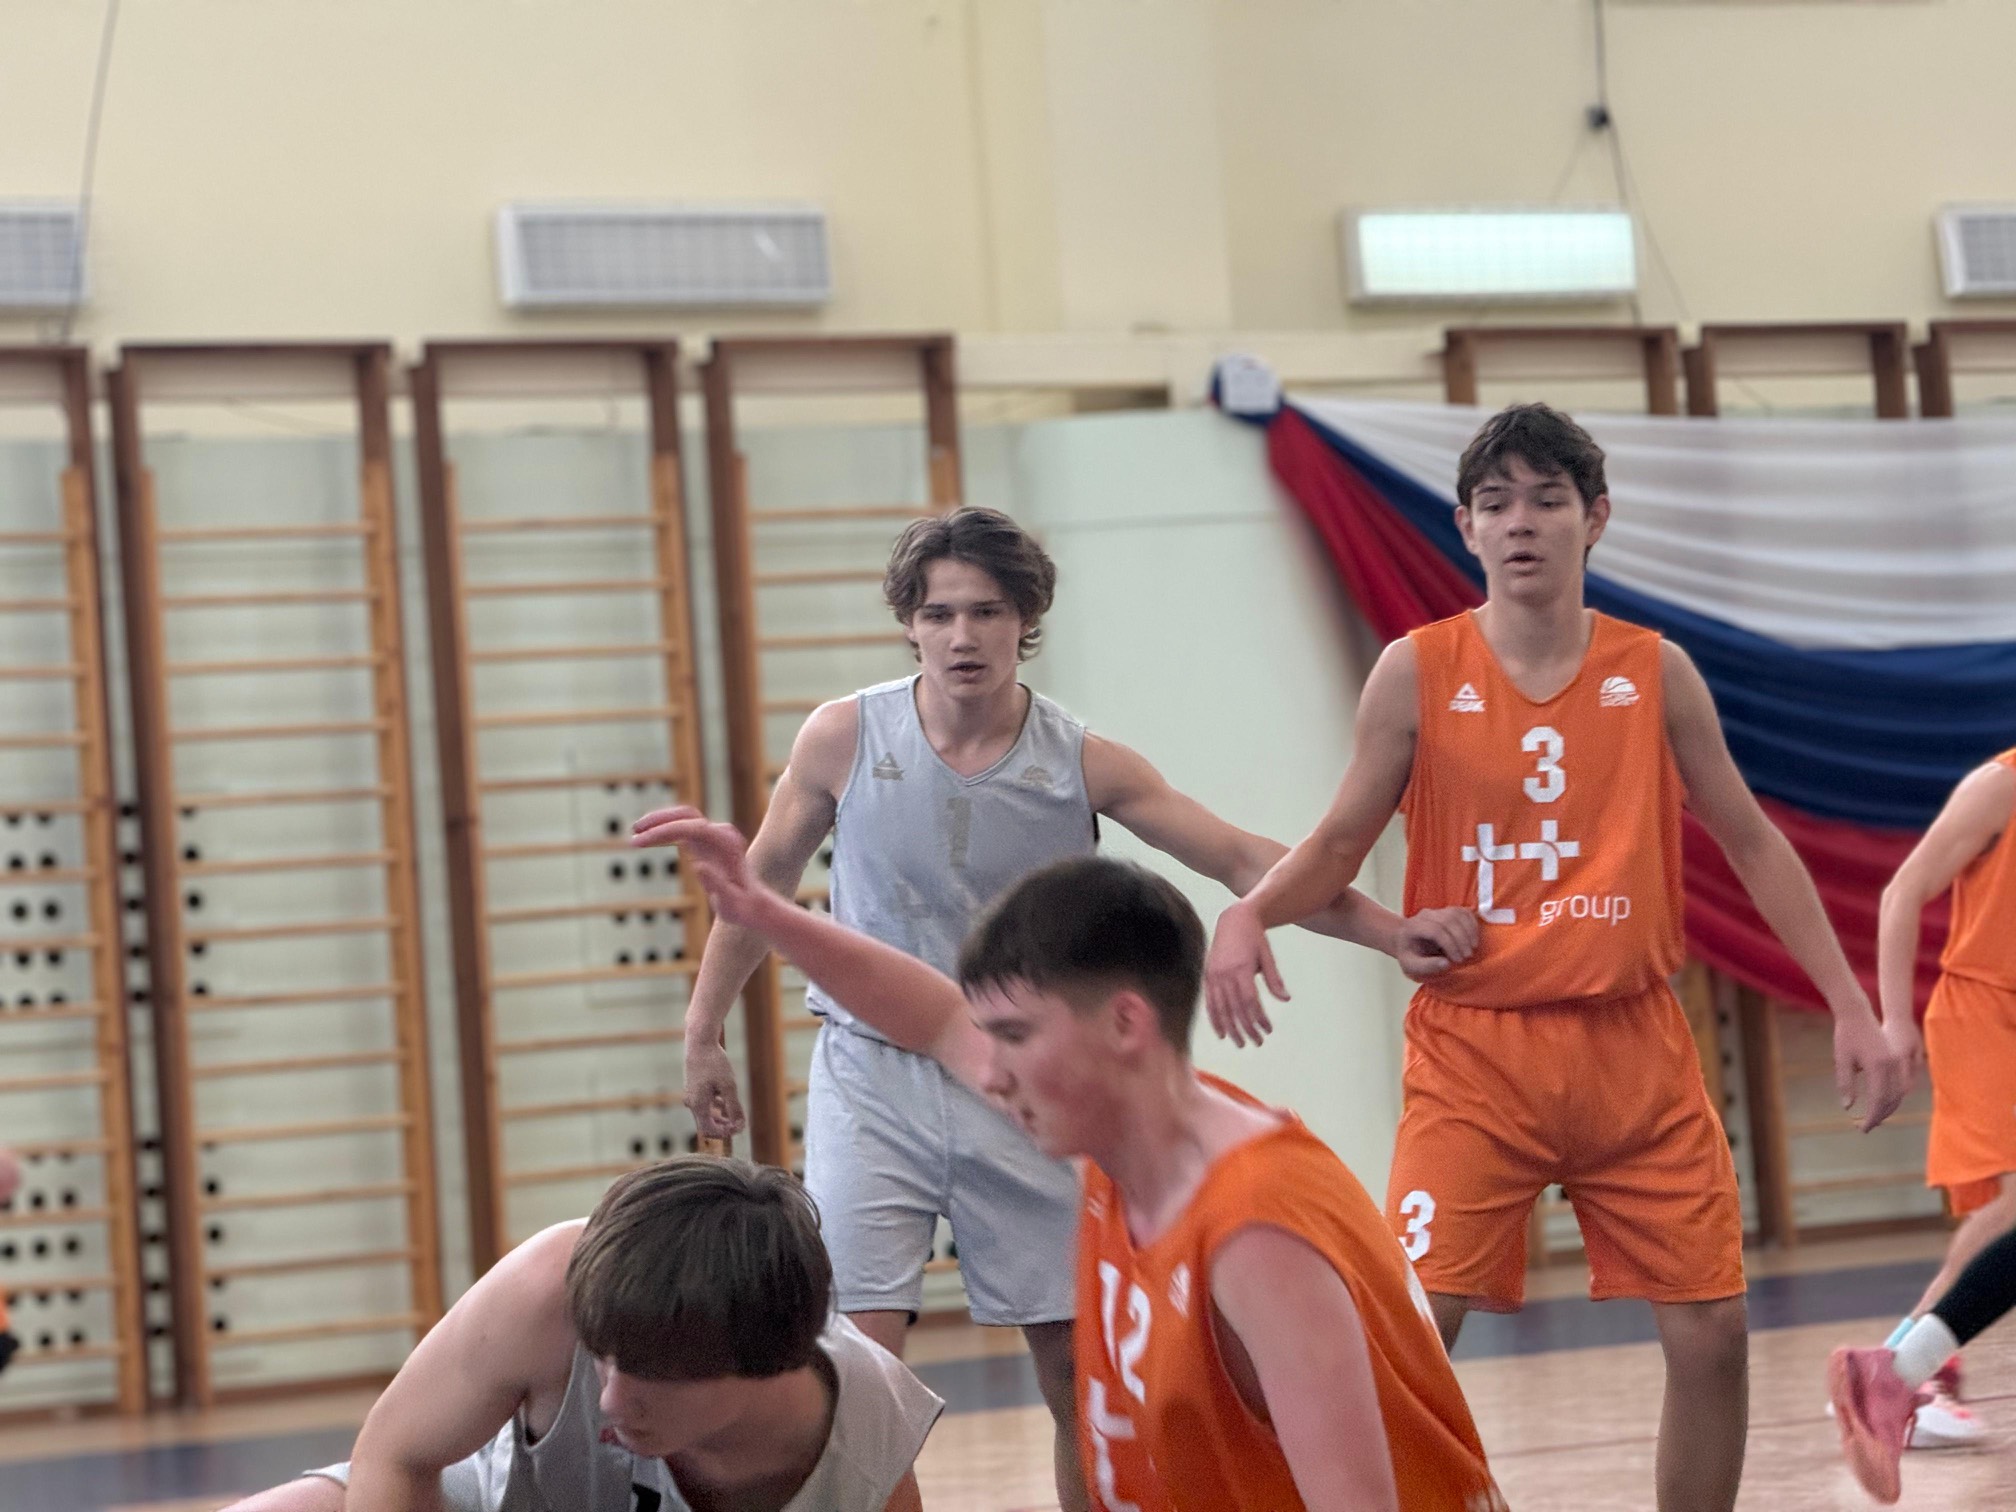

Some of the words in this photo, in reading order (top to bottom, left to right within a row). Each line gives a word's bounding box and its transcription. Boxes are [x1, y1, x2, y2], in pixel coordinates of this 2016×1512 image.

[1521, 726, 1565, 803] 3
[1538, 895, 1632, 927] group
[1398, 1190, 1436, 1262] 3
